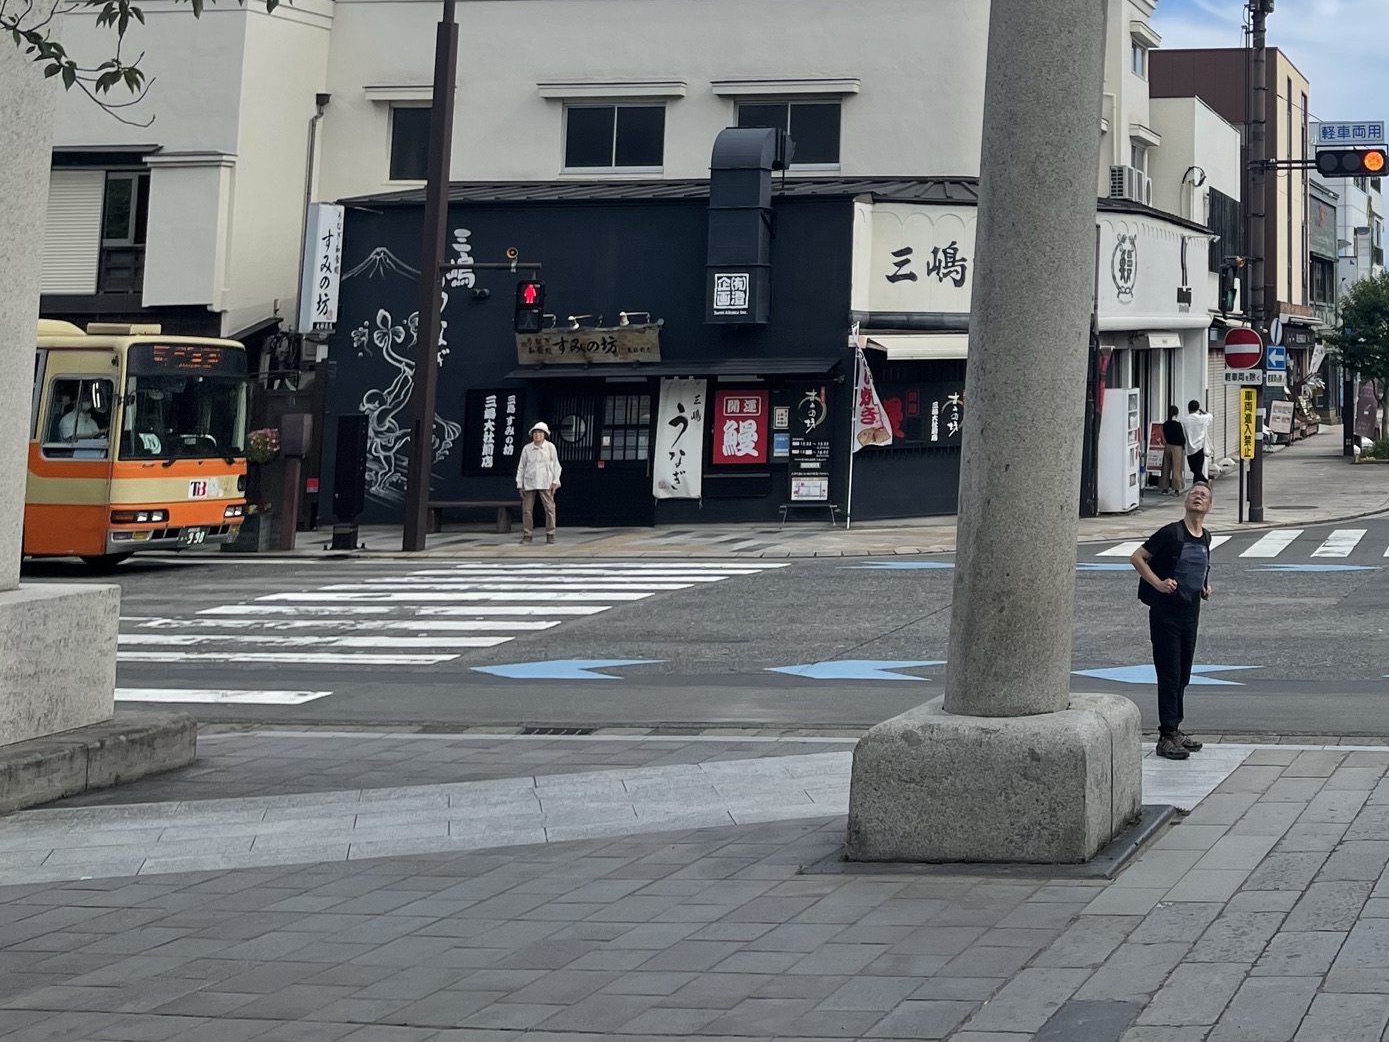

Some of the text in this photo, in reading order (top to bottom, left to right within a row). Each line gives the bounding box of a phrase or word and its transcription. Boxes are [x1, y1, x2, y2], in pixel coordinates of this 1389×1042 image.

[1321, 125, 1381, 140] 軽車両用
[316, 228, 334, 316] すみの坊
[885, 241, 967, 288] 三嶋
[552, 336, 618, 357] すみの坊
[1224, 372, 1261, 382] 軽車両を除く
[727, 399, 758, 414] 開運
[1244, 390, 1254, 458] 車両進入禁止
[667, 402, 689, 491] うなぎ
[722, 419, 759, 457] 鰻
